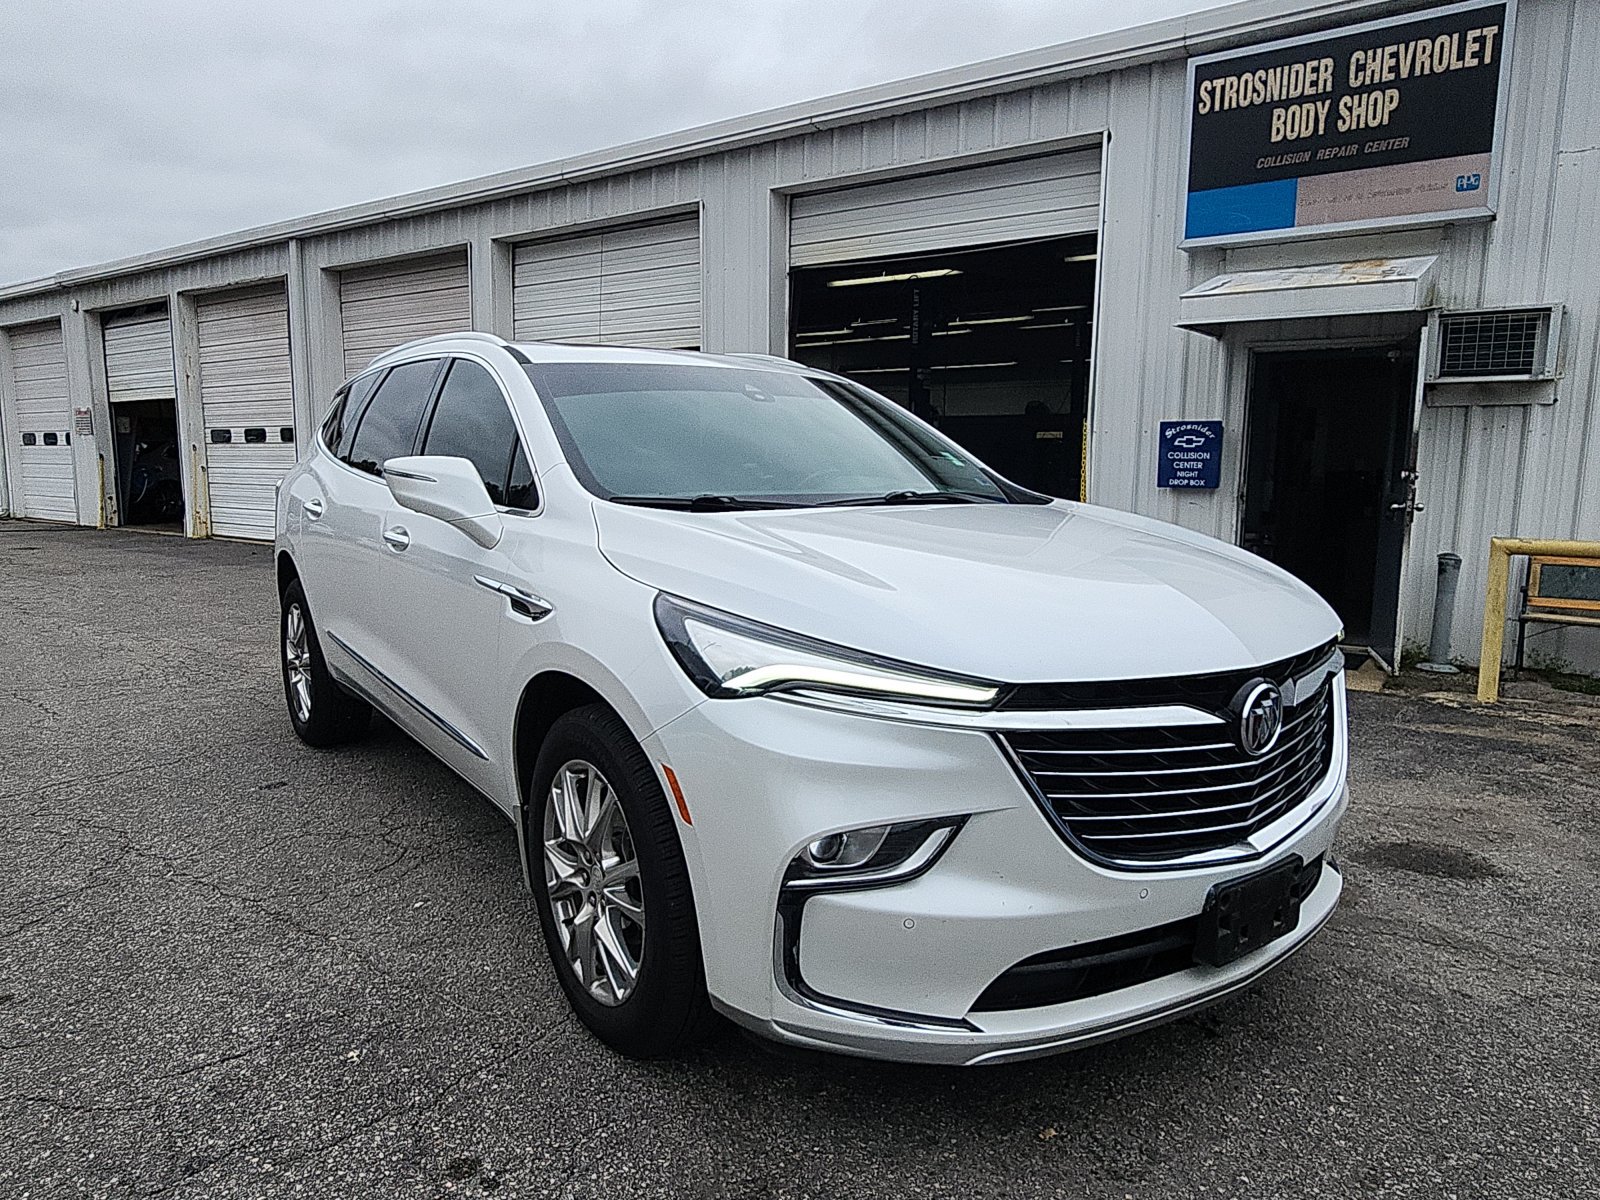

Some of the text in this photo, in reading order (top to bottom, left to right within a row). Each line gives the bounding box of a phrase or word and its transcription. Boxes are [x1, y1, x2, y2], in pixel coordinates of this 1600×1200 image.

[1198, 25, 1500, 115] STROSNIDER CHEVROLET
[1270, 89, 1400, 143] BODY SHOP
[1256, 137, 1410, 170] COLLISION REPAIR CENTER
[1165, 424, 1216, 439] Strosnider
[1167, 452, 1210, 460] COLLISION
